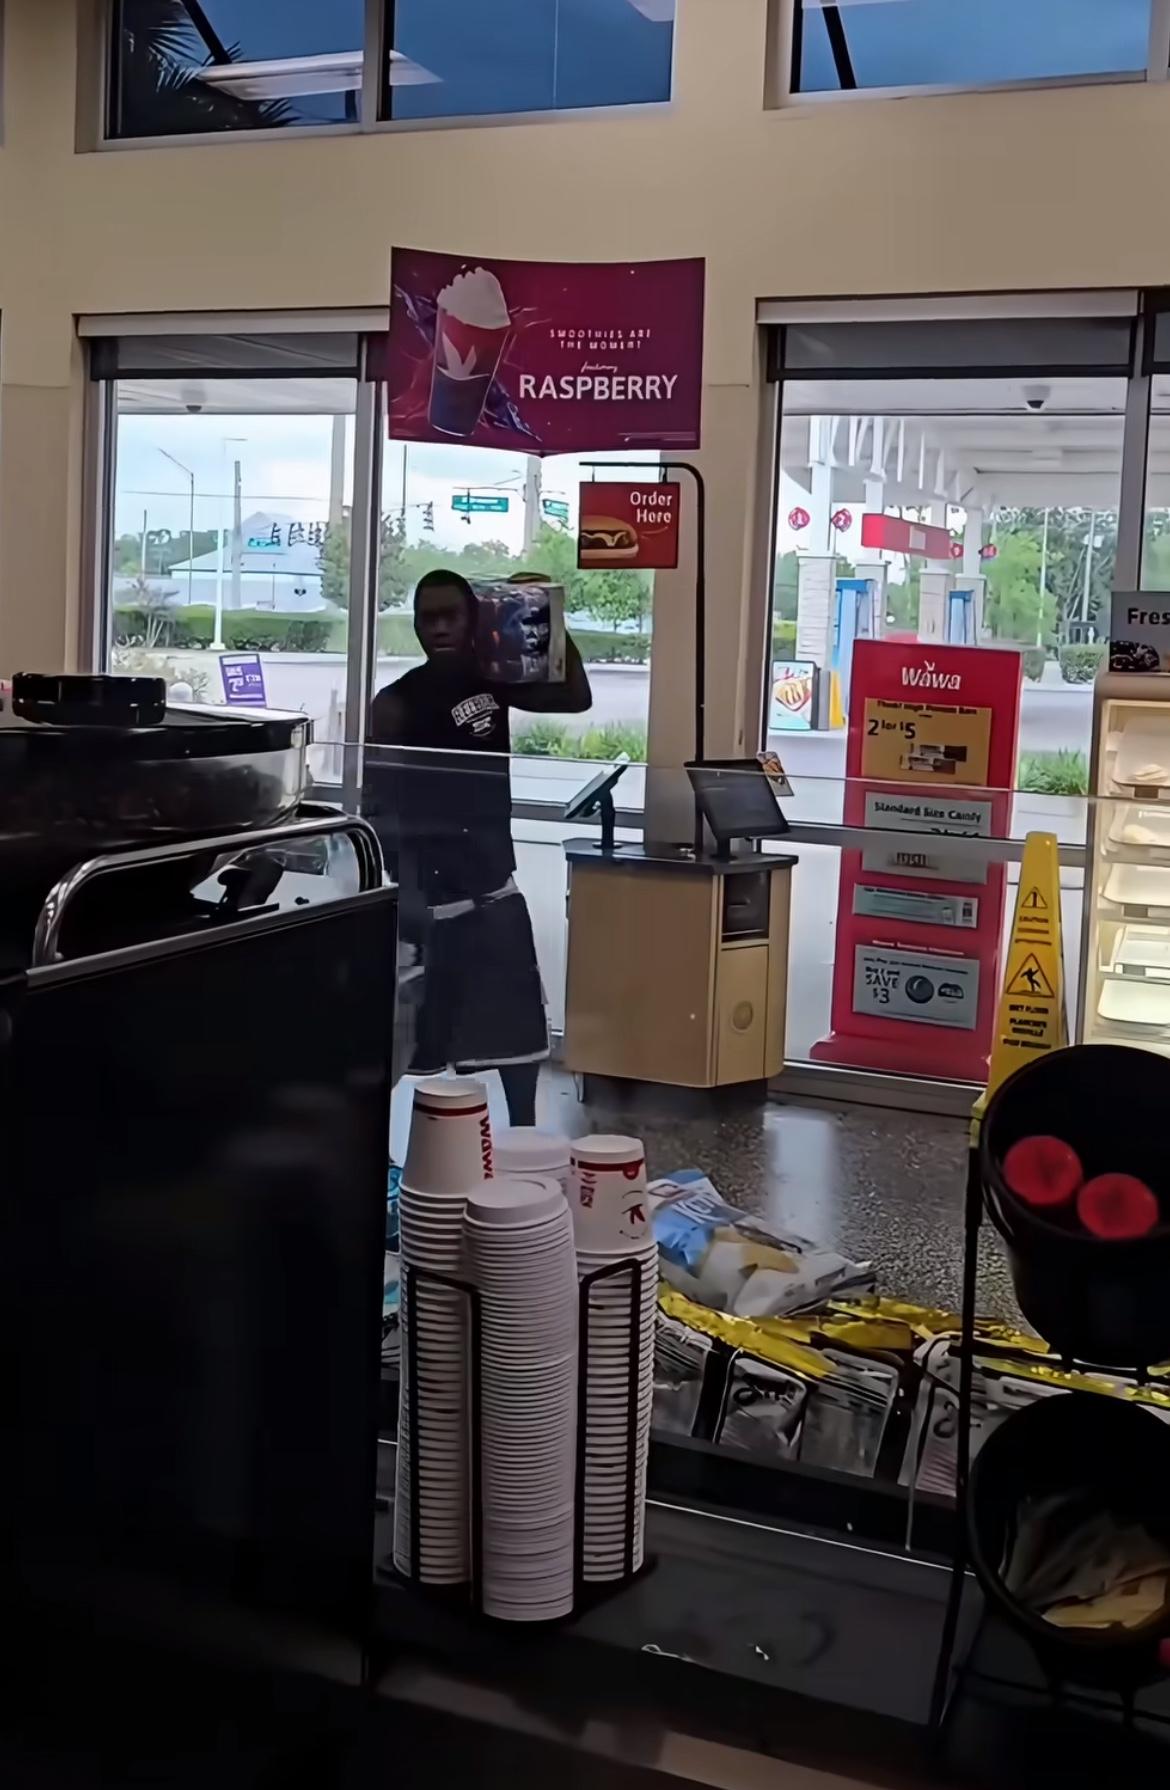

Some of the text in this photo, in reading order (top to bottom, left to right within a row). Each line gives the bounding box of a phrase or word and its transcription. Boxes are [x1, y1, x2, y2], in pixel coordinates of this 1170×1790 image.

[550, 329, 651, 339] SMOOTHIES ARE
[560, 340, 581, 349] THE
[519, 374, 678, 400] RASPBERRY
[630, 491, 672, 507] Order
[636, 508, 672, 524] Here
[902, 664, 961, 690] Wawa
[867, 719, 879, 736] 2
[875, 802, 921, 816] Standard
[948, 810, 981, 823] Candy
[866, 974, 898, 989] SAVE
